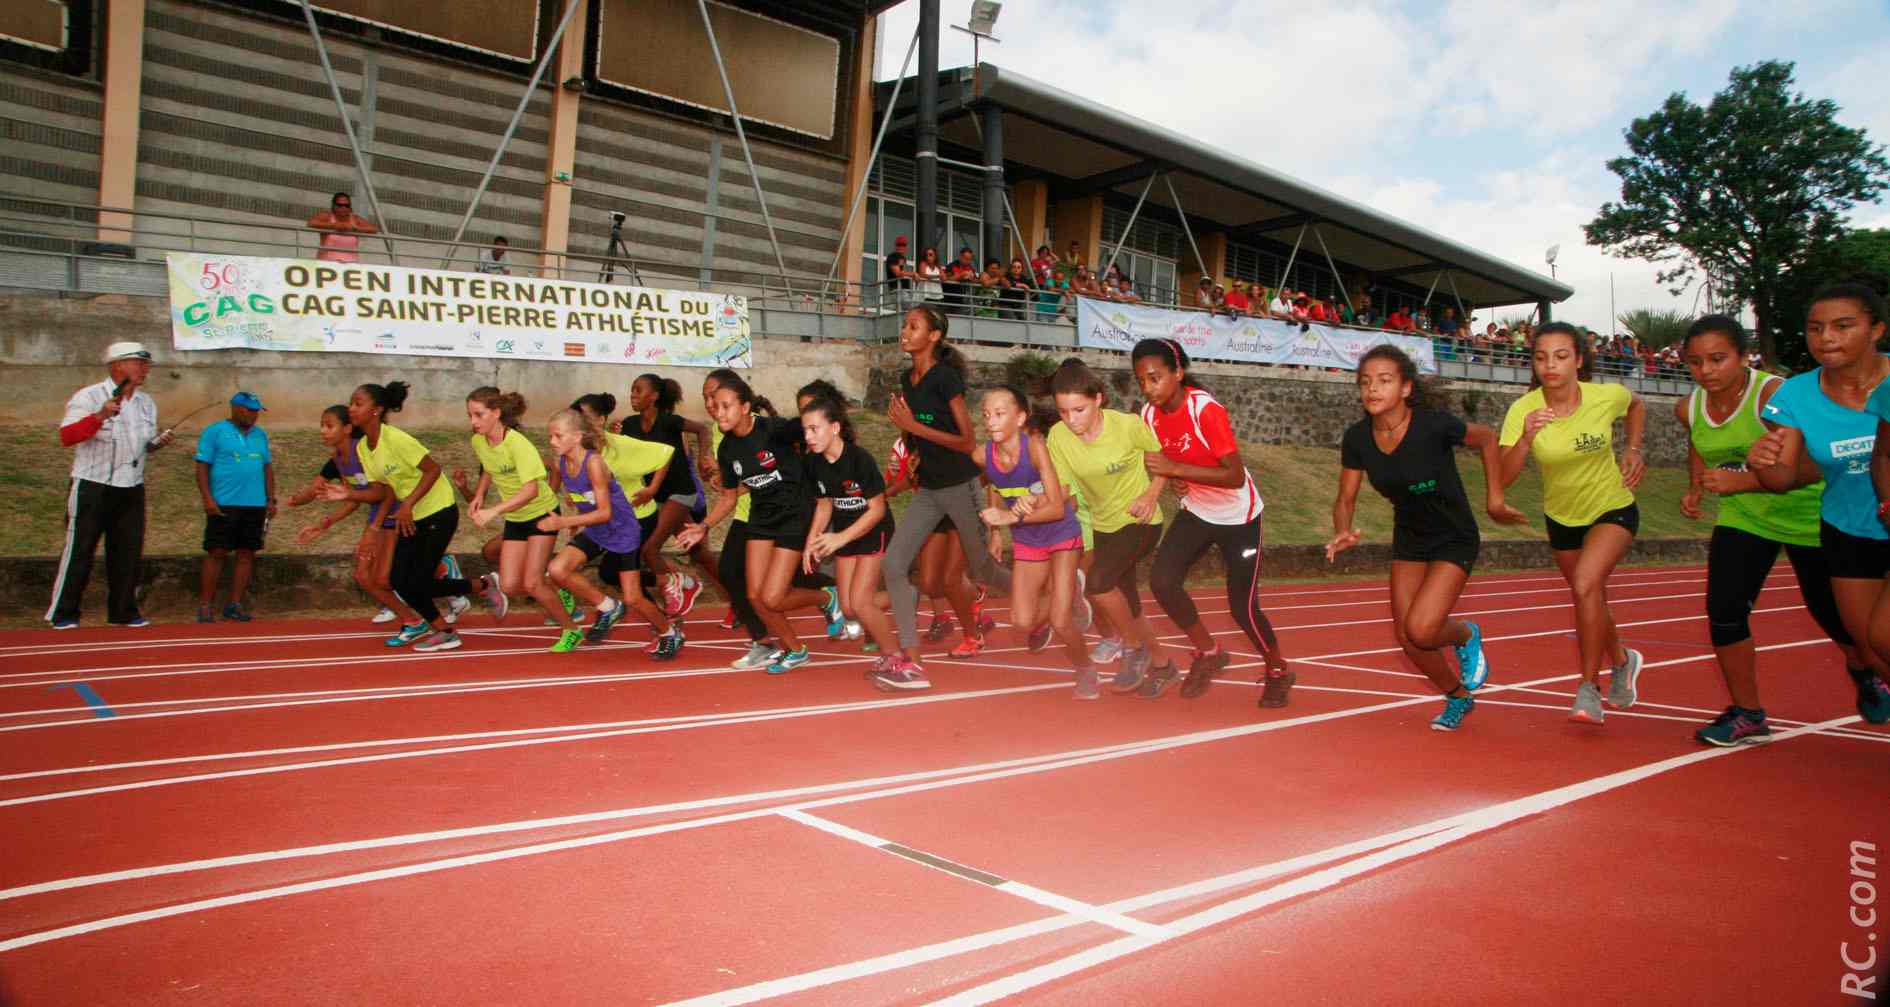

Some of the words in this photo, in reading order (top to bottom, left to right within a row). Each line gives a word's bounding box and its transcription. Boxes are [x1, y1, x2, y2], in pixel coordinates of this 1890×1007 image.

[183, 293, 273, 326] CAG
[284, 265, 391, 293] OPEN
[408, 273, 670, 313] INTERNATIONAL
[680, 300, 709, 316] DU
[281, 292, 345, 317] CAG
[357, 298, 557, 329] SAINT-PIERRE
[566, 309, 715, 338] ATHLÉTISME
[1835, 440, 1873, 454] DECAT
